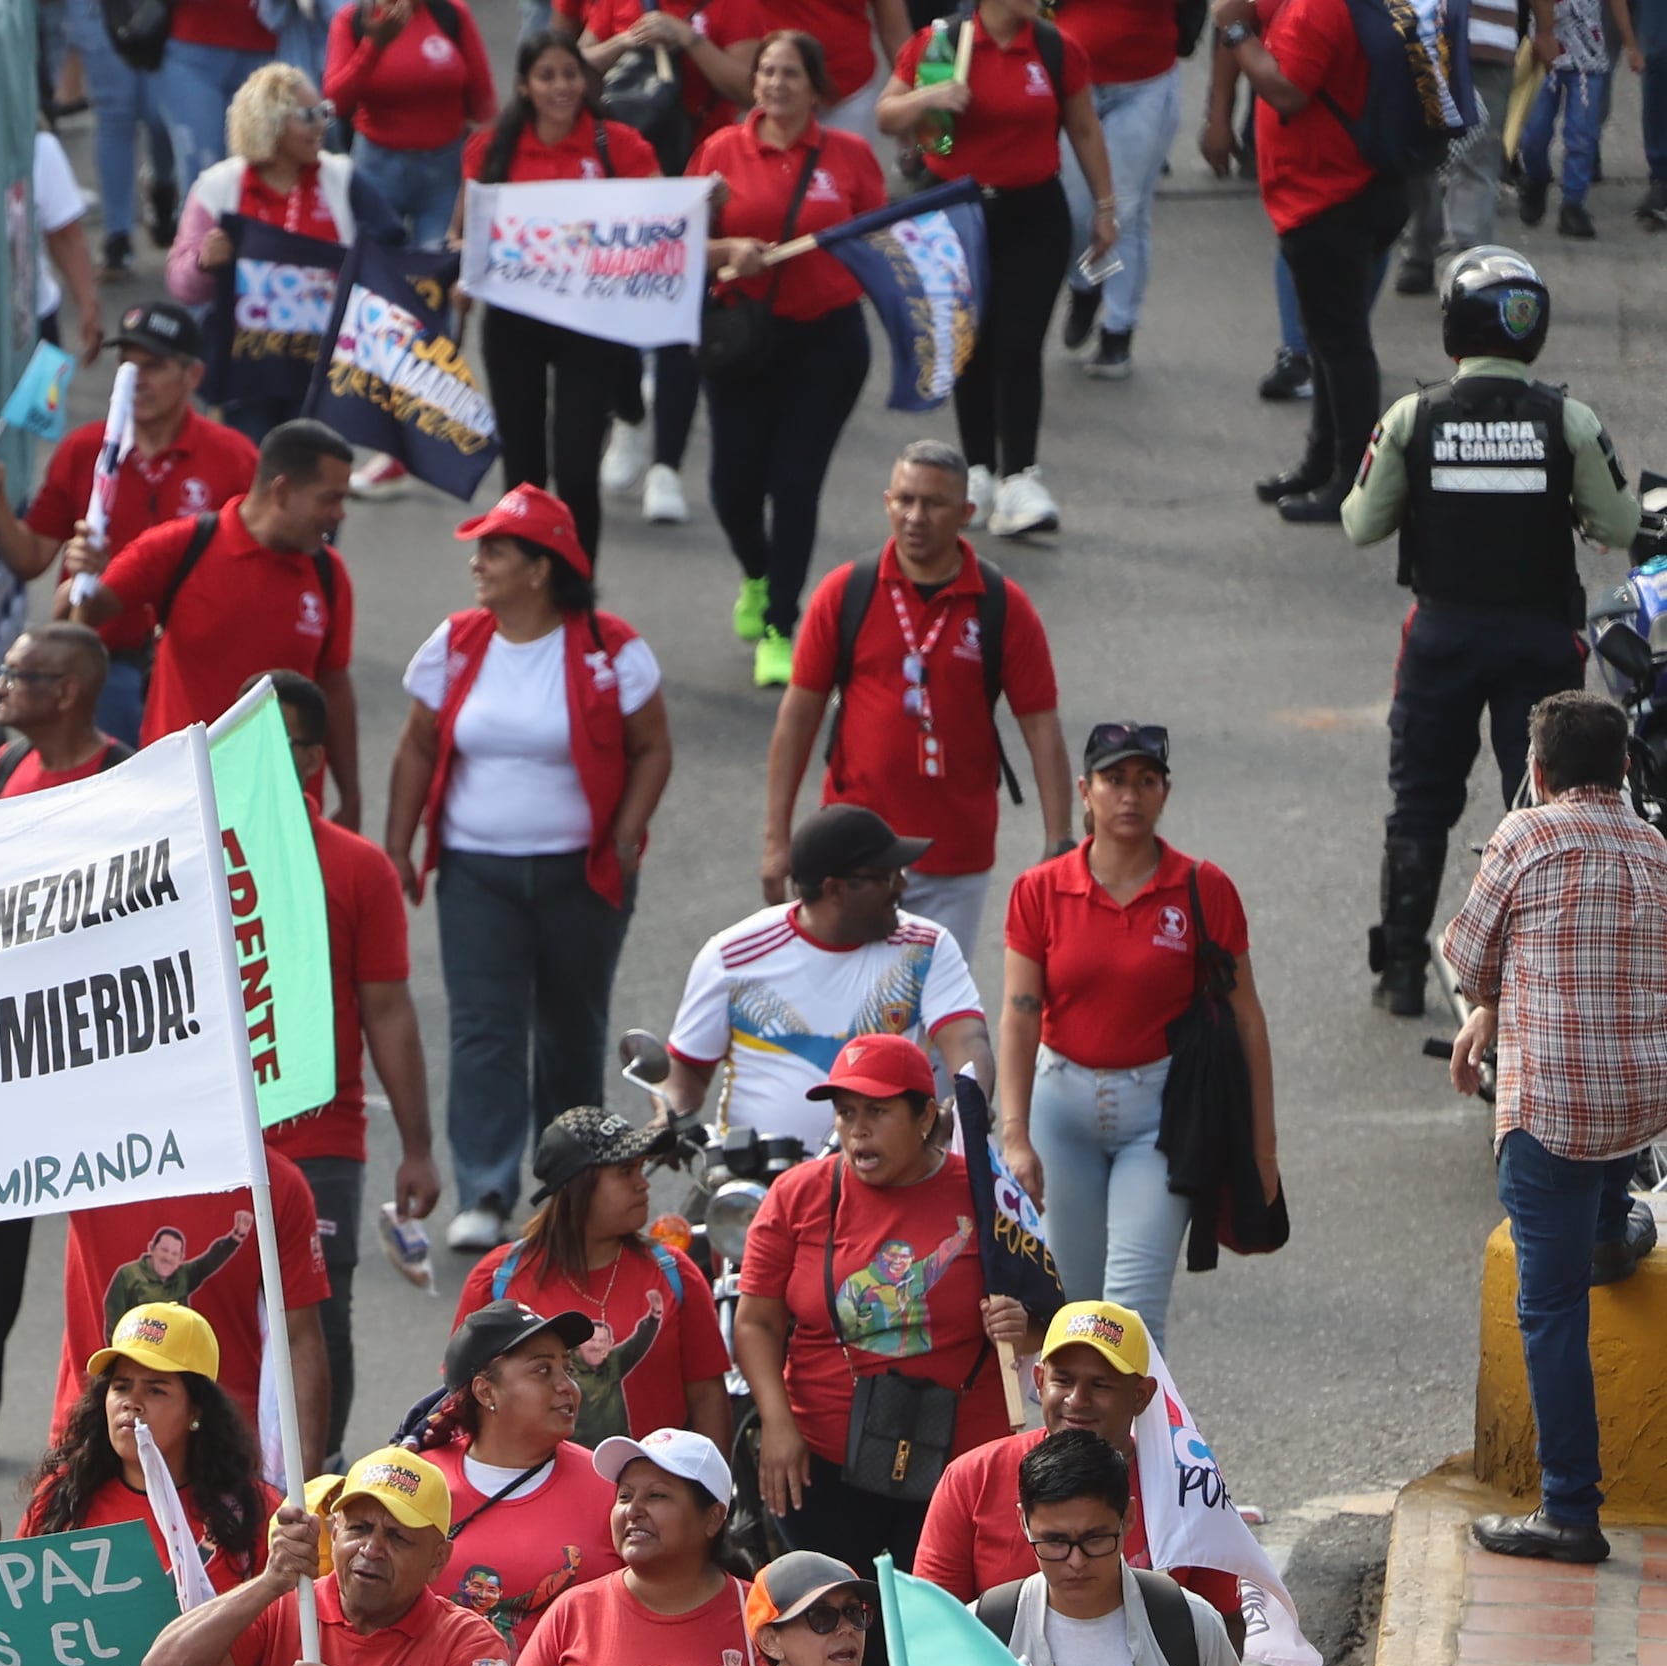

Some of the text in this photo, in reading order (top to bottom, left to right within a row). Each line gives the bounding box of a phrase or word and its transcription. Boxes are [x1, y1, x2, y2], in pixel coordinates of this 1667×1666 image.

[592, 218, 687, 248] JURO
[1442, 420, 1536, 442] POLICIA
[1434, 439, 1546, 462] DE CARACAS
[1097, 1314, 1125, 1333] JURO
[391, 1466, 422, 1483] JURO
